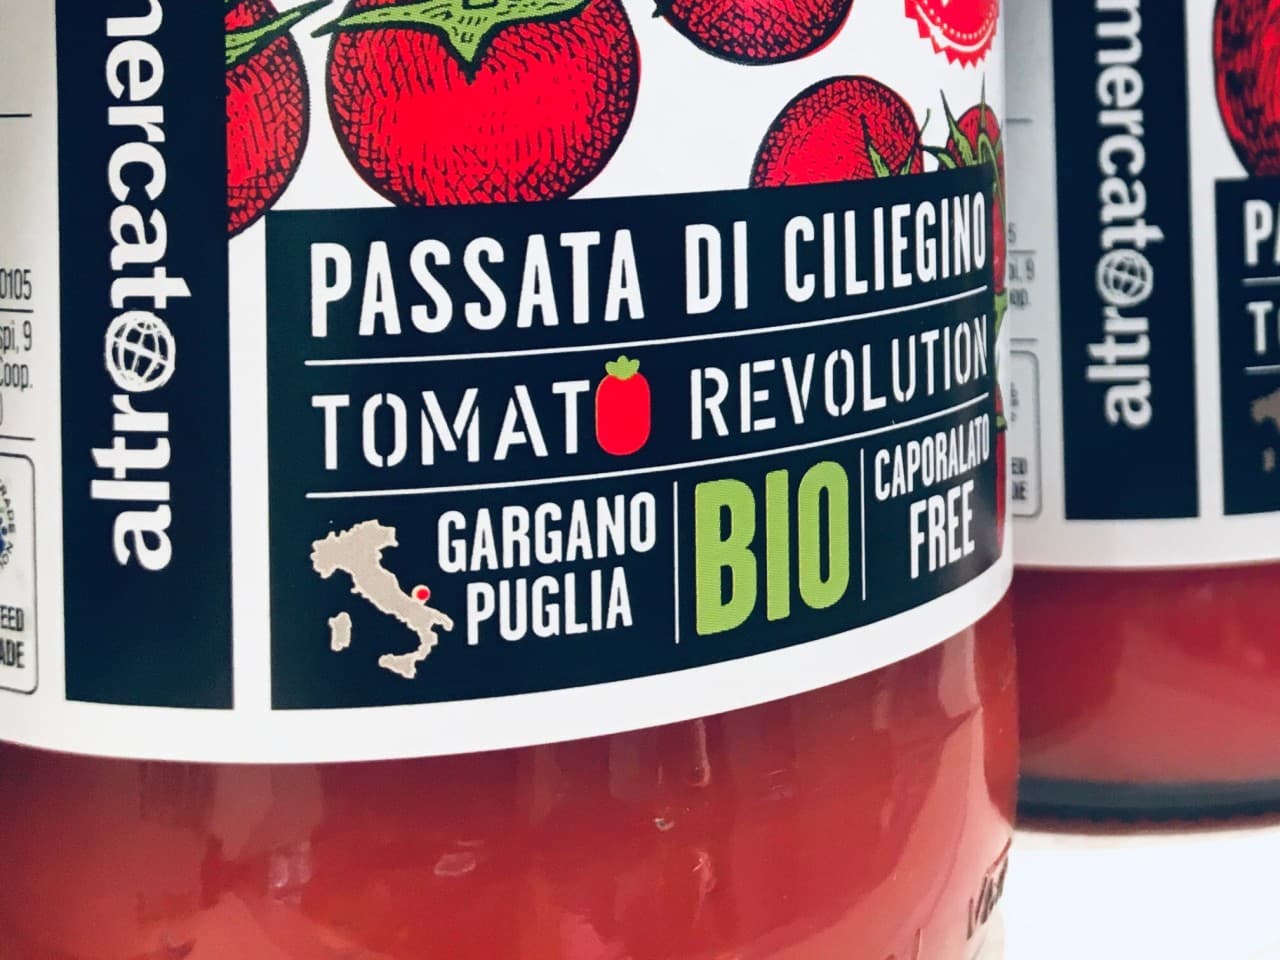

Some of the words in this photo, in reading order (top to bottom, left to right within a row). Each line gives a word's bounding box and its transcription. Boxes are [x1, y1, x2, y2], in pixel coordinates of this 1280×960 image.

[309, 228, 647, 338] PASSATA
[684, 219, 749, 316] DI
[784, 190, 988, 302] CILIEGINO
[23, 320, 33, 352] 9
[689, 313, 988, 440] REVOLUTION
[873, 412, 991, 503] CAPORALATO
[436, 491, 657, 574] GARGANO
[694, 460, 851, 637] BIO
[909, 479, 976, 580] FREE
[466, 566, 634, 646] PUGLIA
